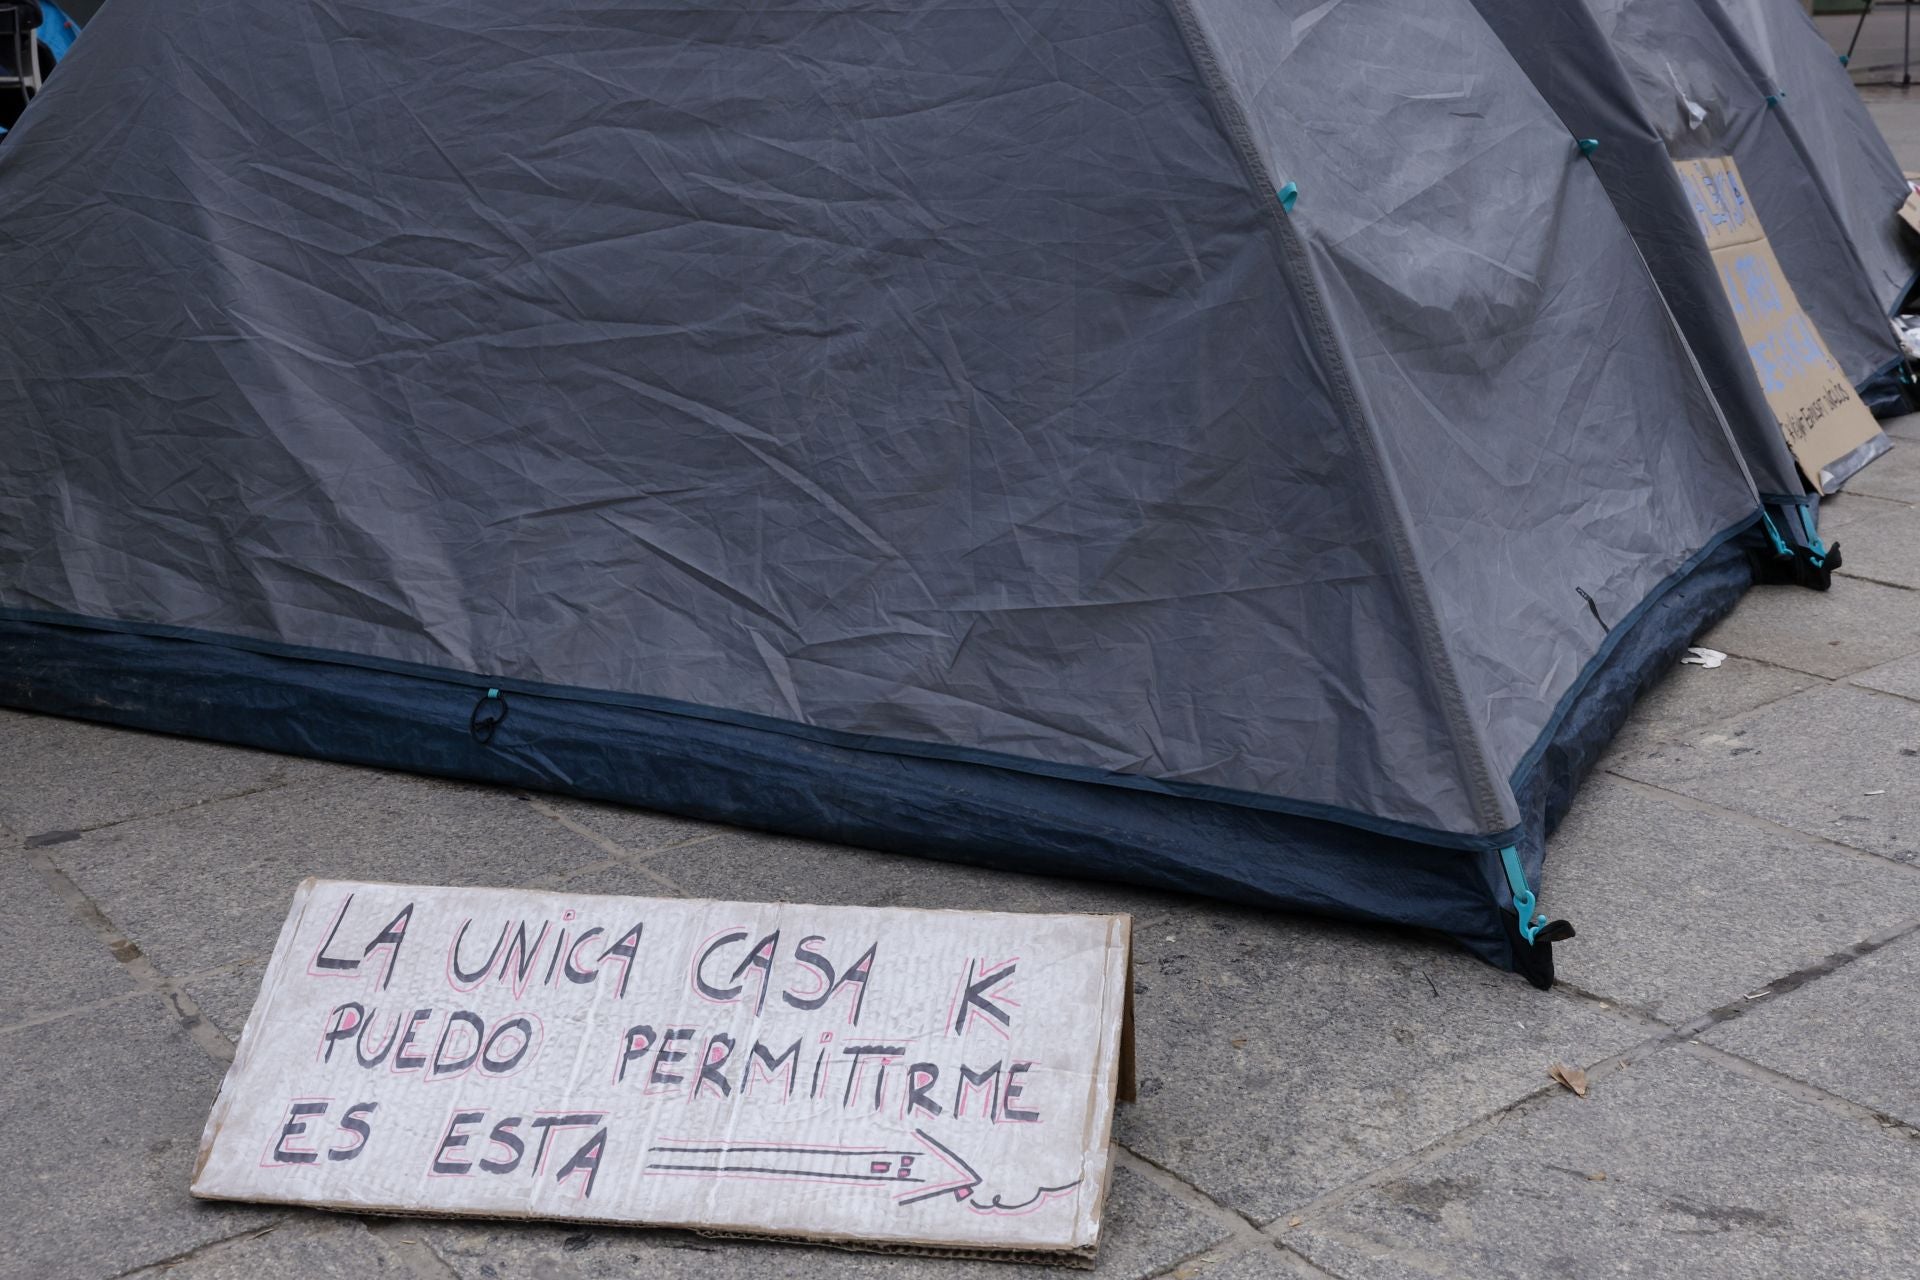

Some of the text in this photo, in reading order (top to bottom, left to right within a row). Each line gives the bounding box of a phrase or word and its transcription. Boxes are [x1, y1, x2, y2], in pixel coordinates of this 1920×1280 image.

[309, 892, 414, 991] LA
[691, 926, 878, 1026] CASA
[946, 957, 1021, 1040] K
[317, 1002, 544, 1083] PUEDO
[260, 1097, 609, 1198] ES ESTA
